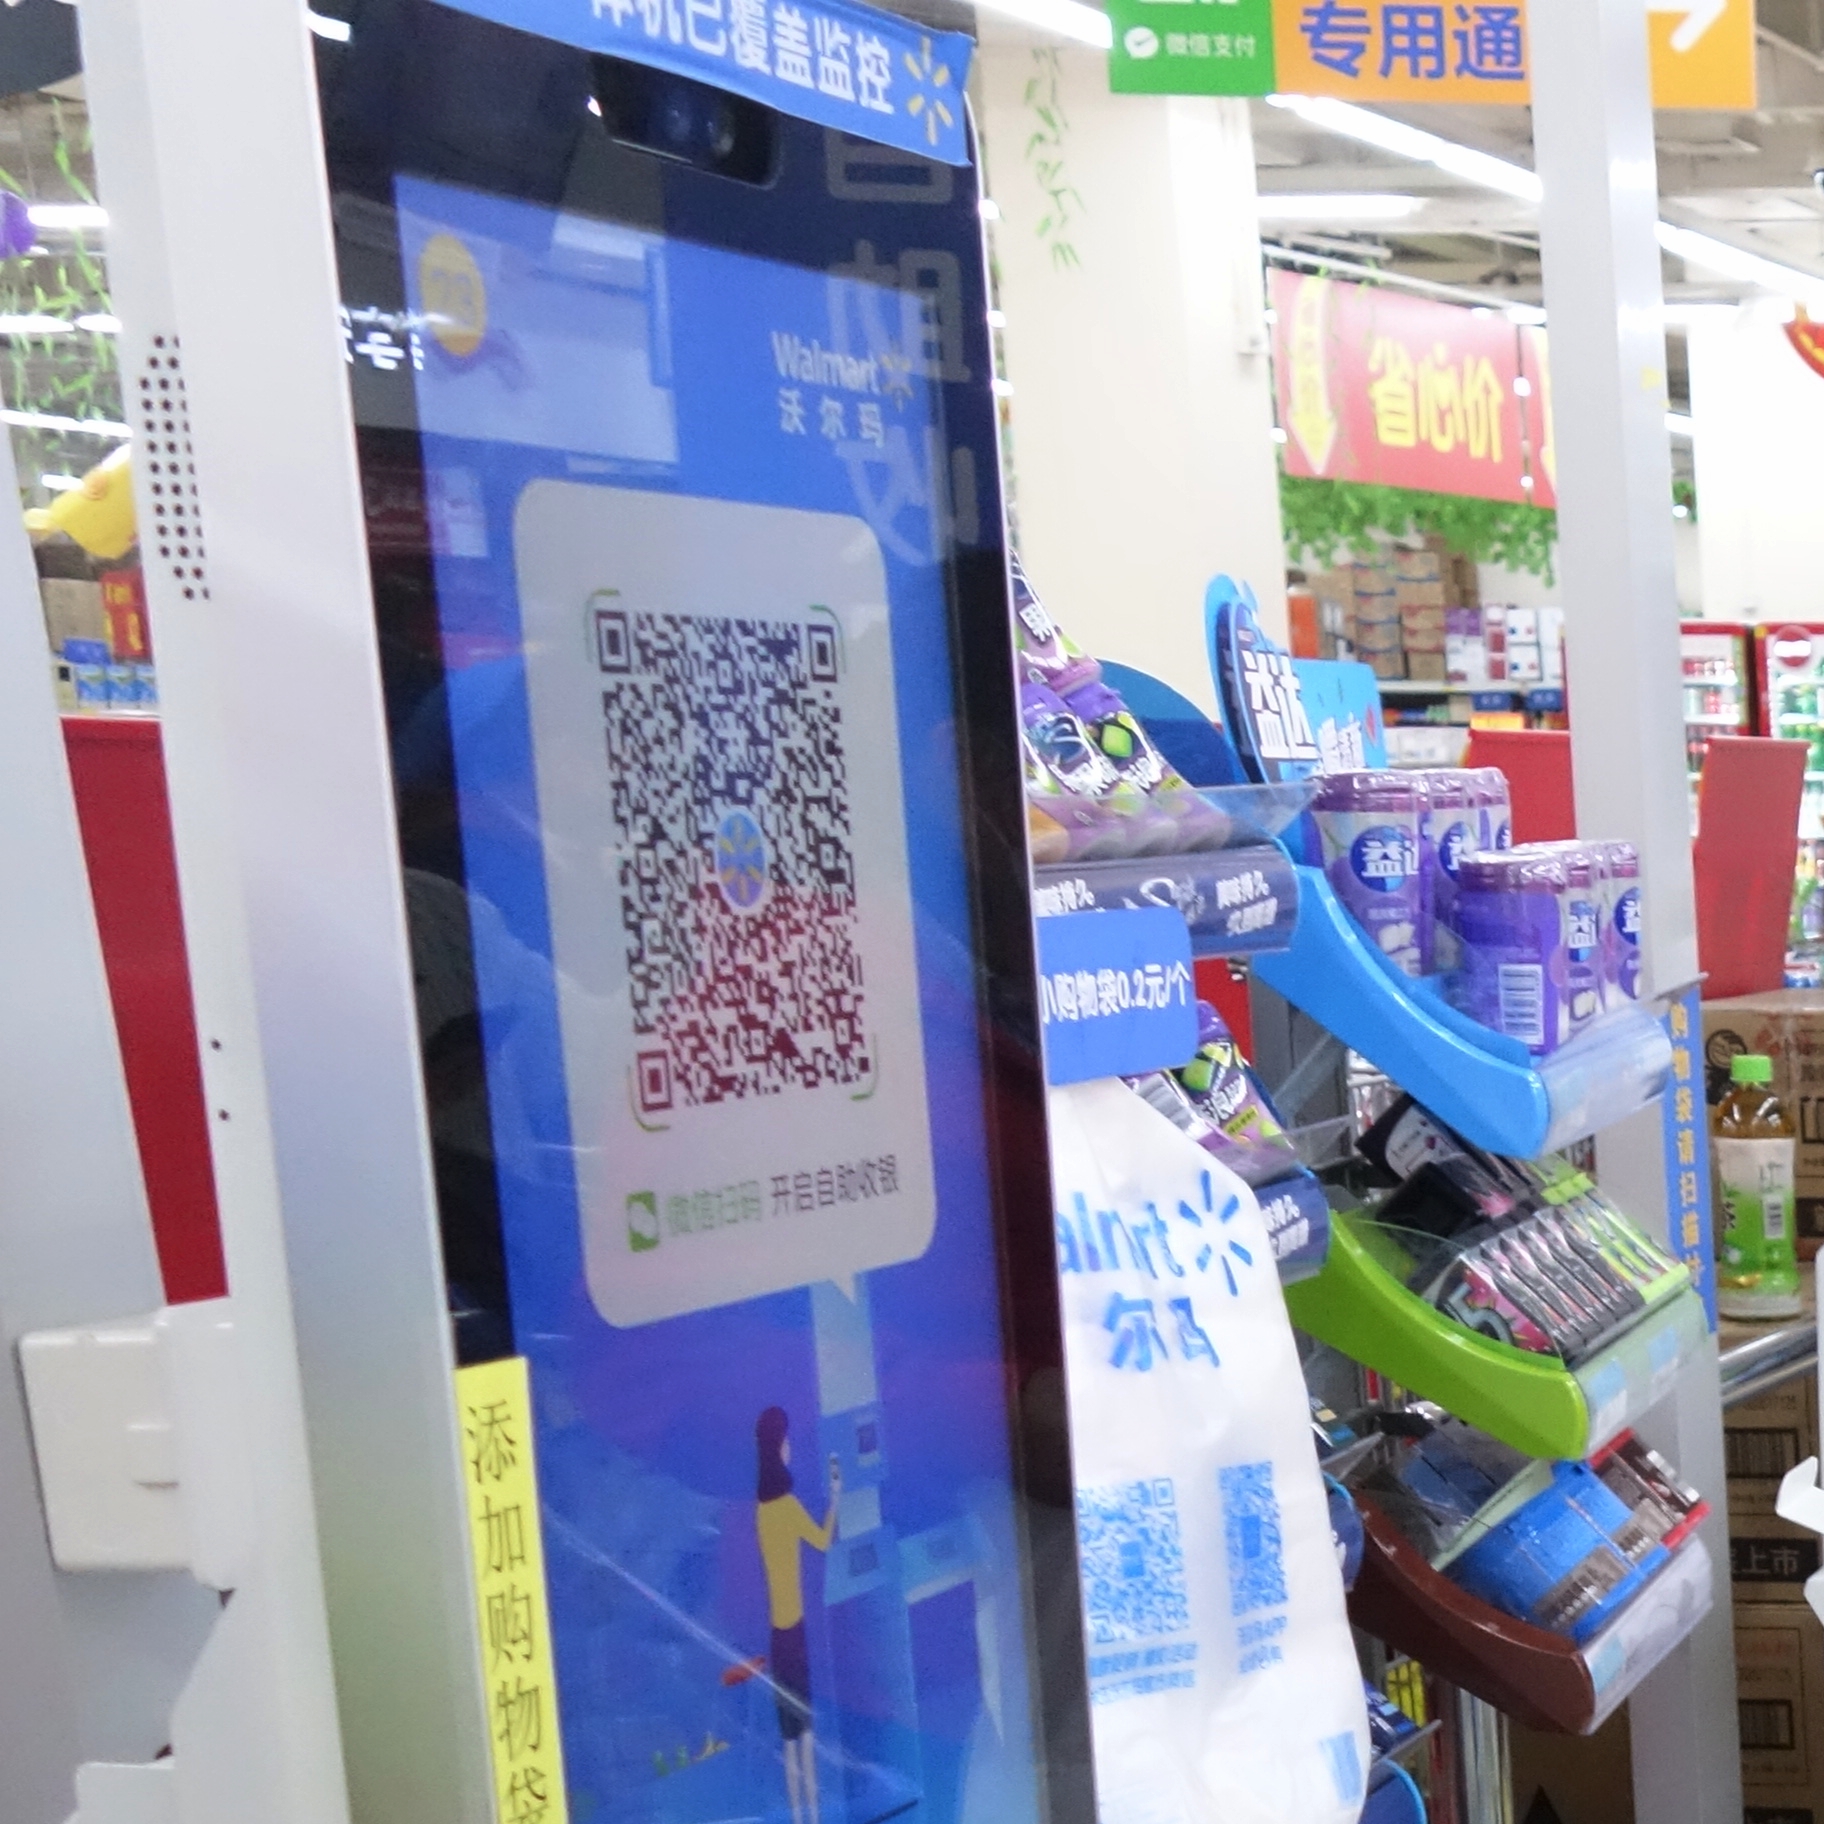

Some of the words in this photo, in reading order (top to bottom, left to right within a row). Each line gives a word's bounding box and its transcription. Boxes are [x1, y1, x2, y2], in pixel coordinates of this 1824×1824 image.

[1165, 31, 1257, 59] 微信支付
[1299, 1, 1527, 82] 专用通
[771, 330, 884, 394] Walmart
[777, 391, 887, 448] 沃尔玛
[769, 1153, 901, 1218] 开启自助收银
